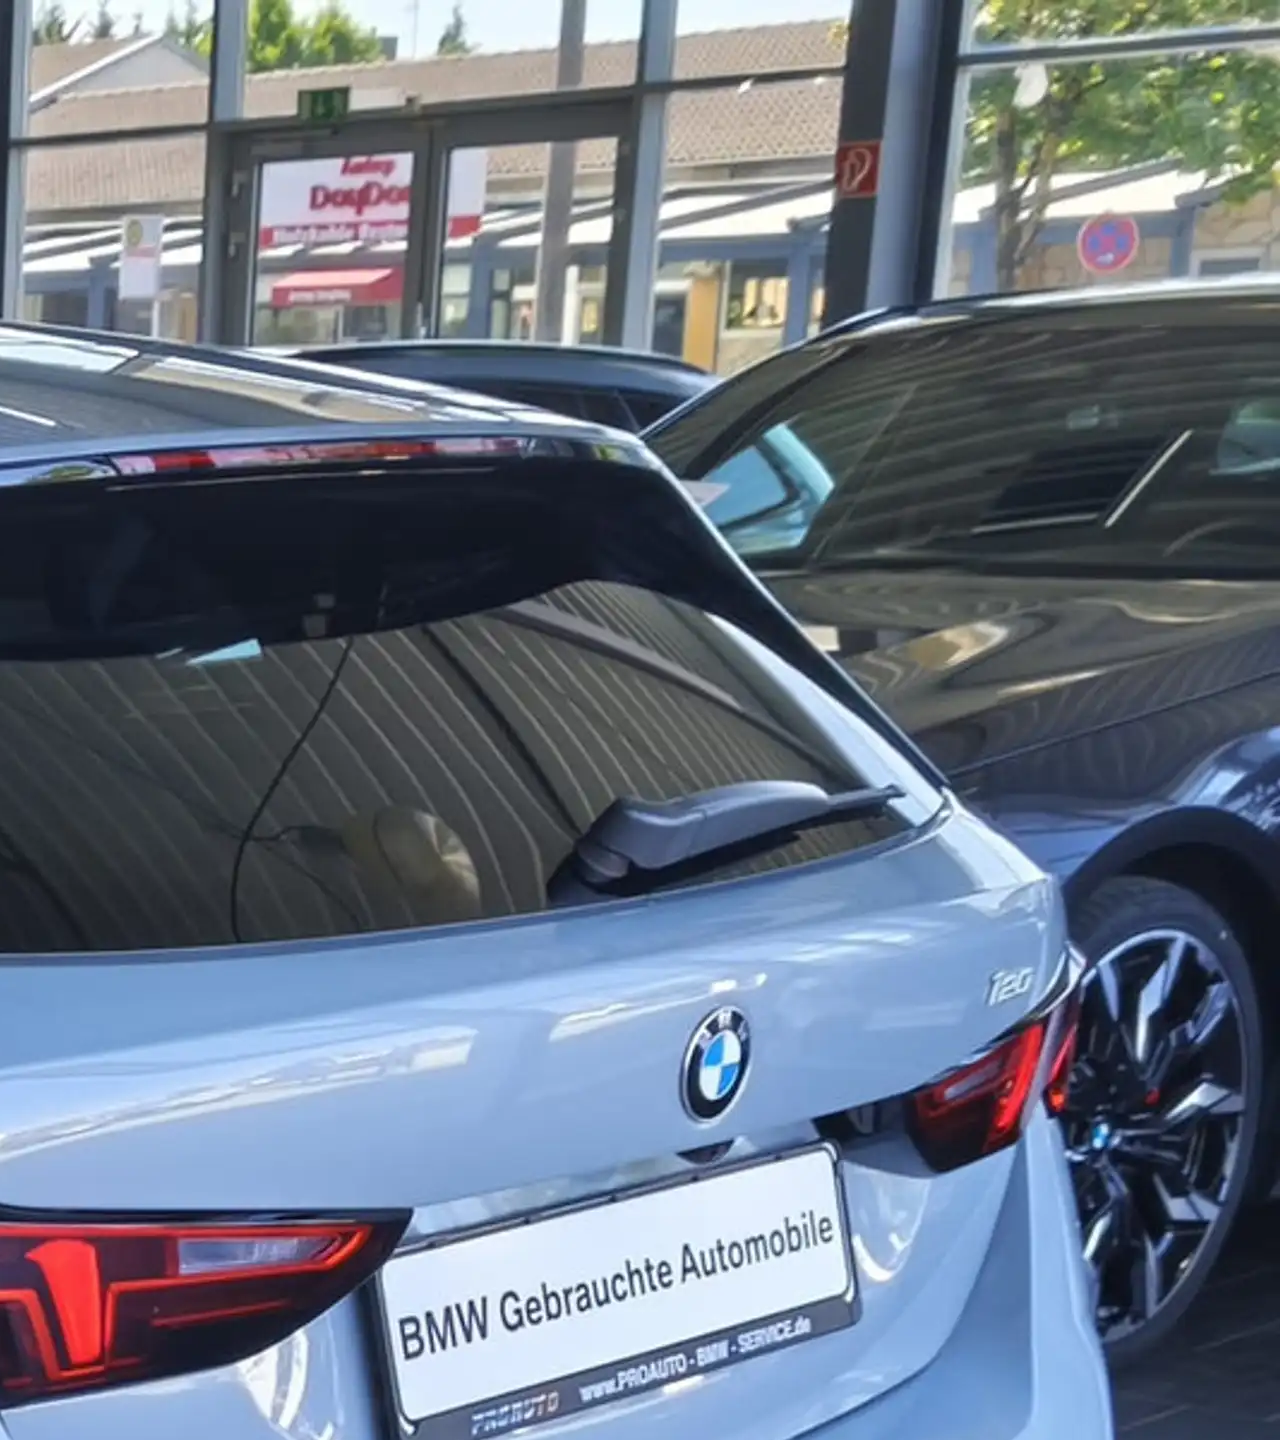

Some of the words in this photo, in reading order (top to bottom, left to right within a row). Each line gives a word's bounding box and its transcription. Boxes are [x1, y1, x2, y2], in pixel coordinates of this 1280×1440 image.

[989, 966, 1033, 1006] 120
[398, 1297, 489, 1360] BMW
[498, 1257, 673, 1332] Gebrauchte
[680, 1210, 834, 1283] Automobile
[737, 1314, 812, 1353] SERVICE.de
